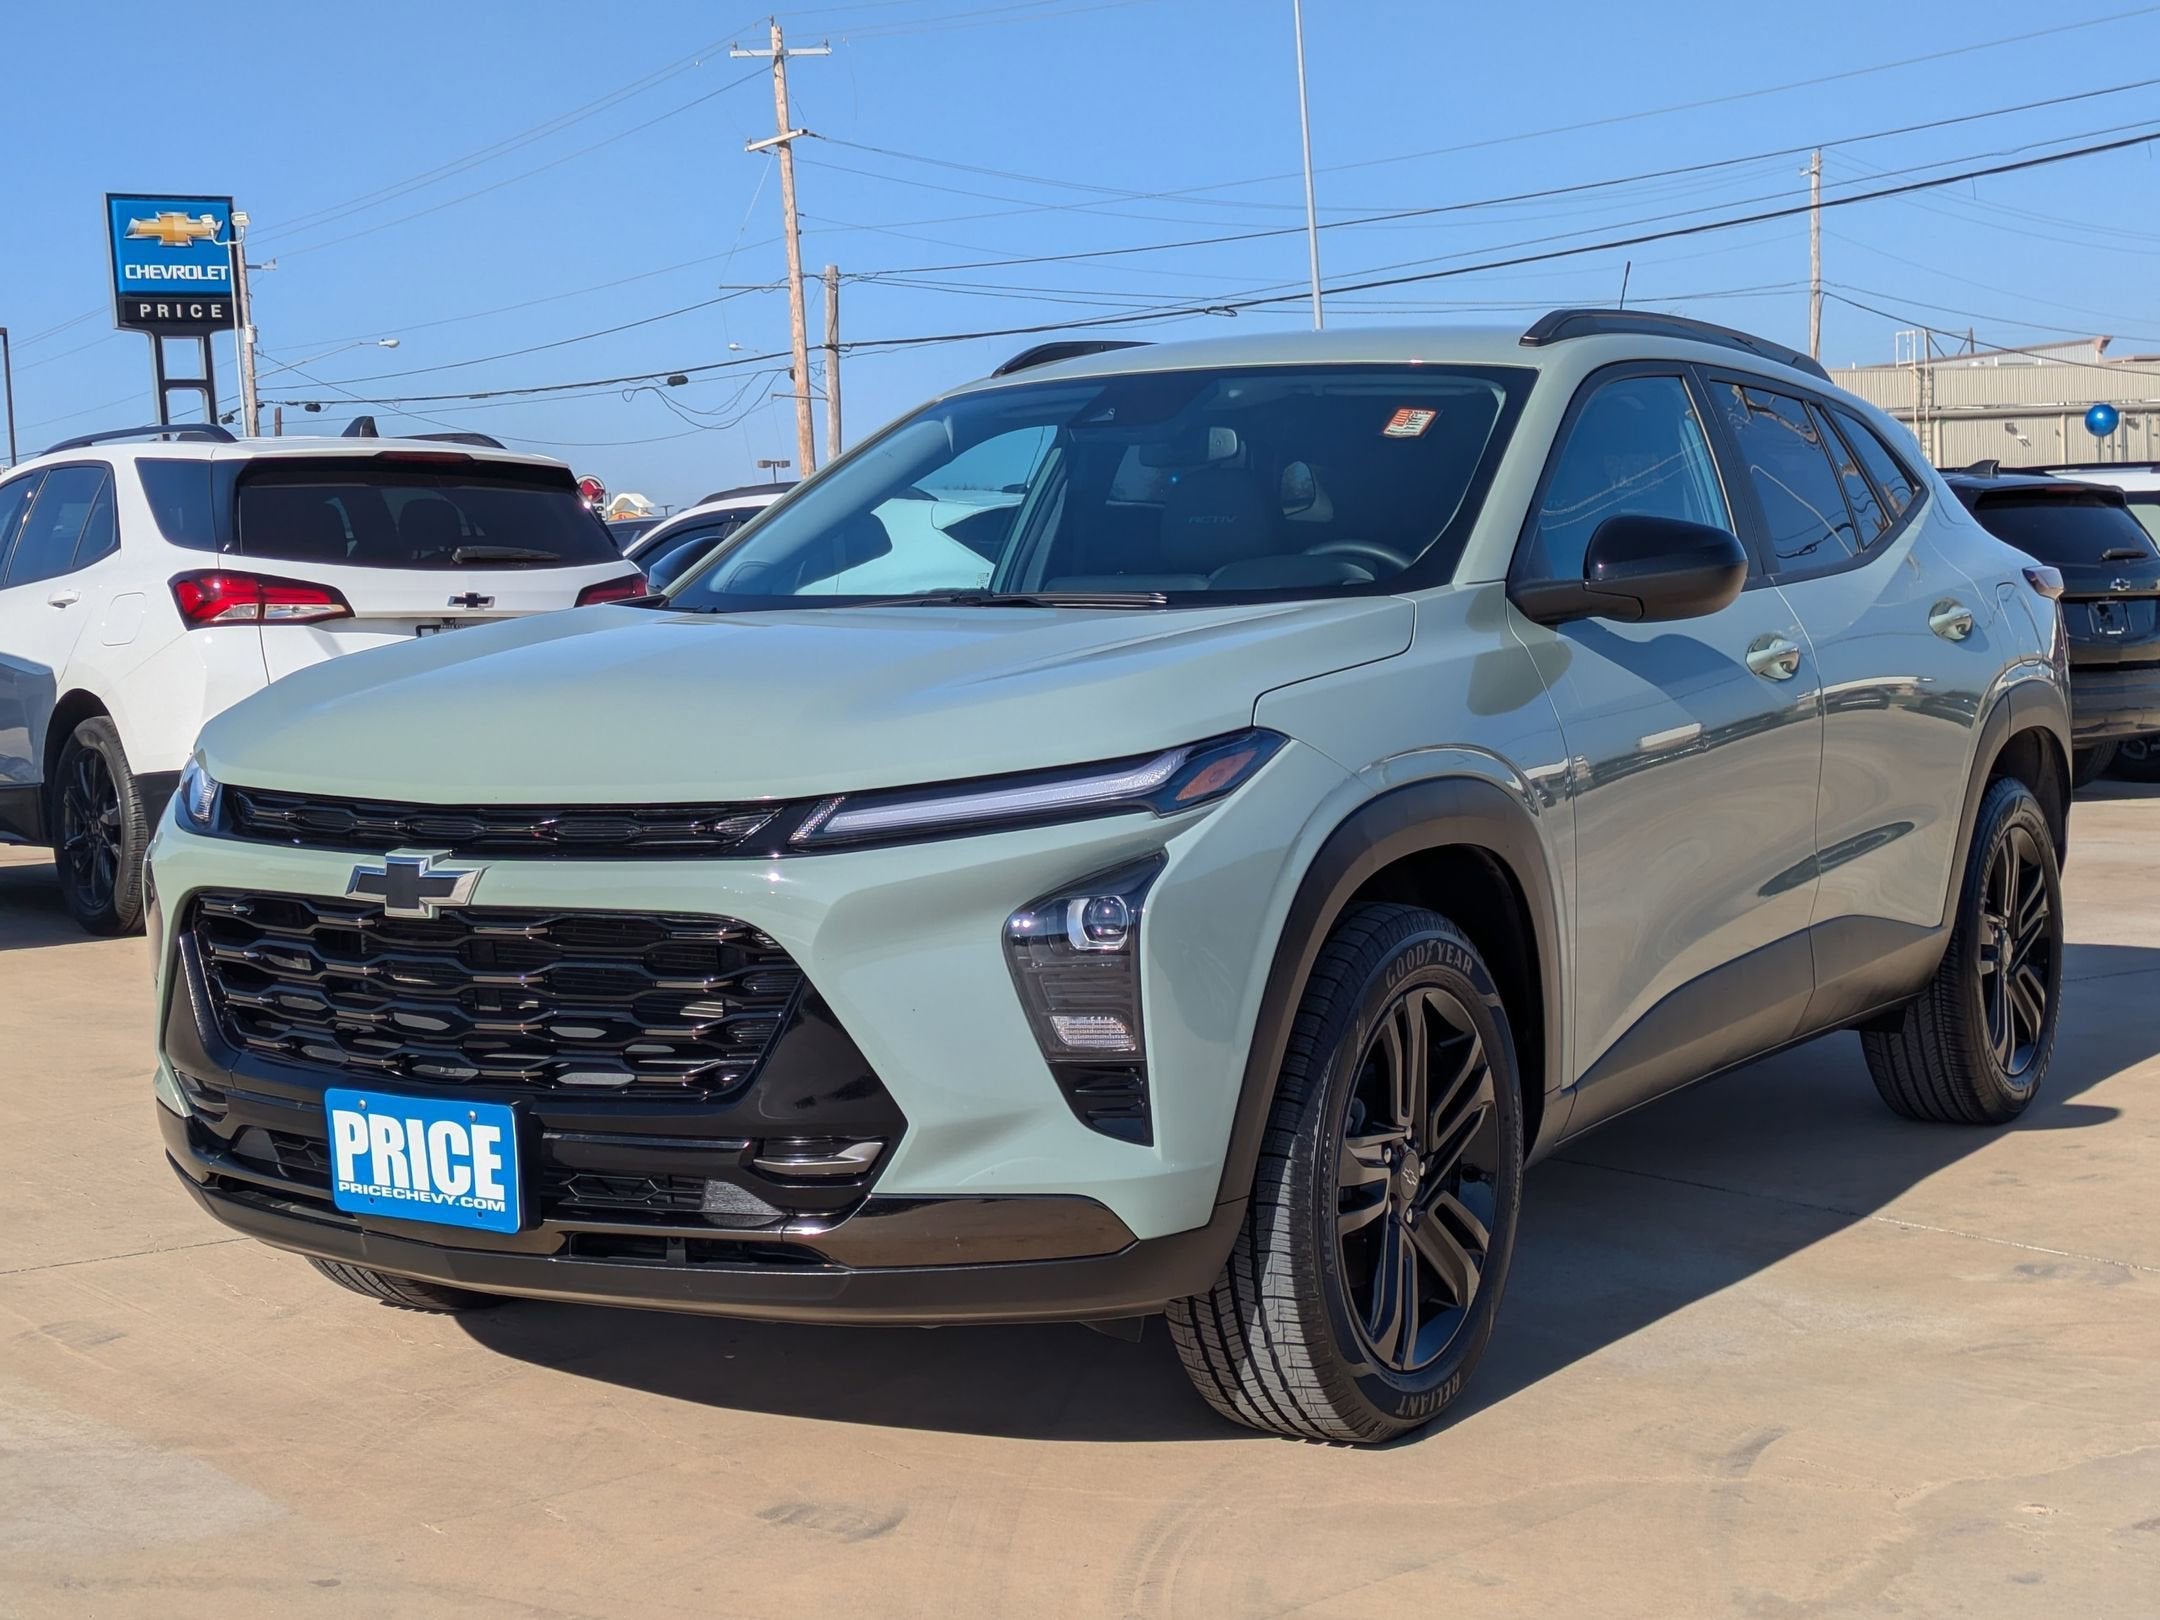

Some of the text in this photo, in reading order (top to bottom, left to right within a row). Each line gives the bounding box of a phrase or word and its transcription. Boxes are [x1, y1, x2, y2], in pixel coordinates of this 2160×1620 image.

[125, 264, 228, 280] CHEVROLET
[140, 304, 223, 317] PRICE
[1385, 939, 1473, 989] GOODYEAR
[332, 1109, 505, 1201] PRICE
[338, 1181, 506, 1212] PRICECHEVY.COM
[1395, 1371, 1460, 1416] RELIANT
